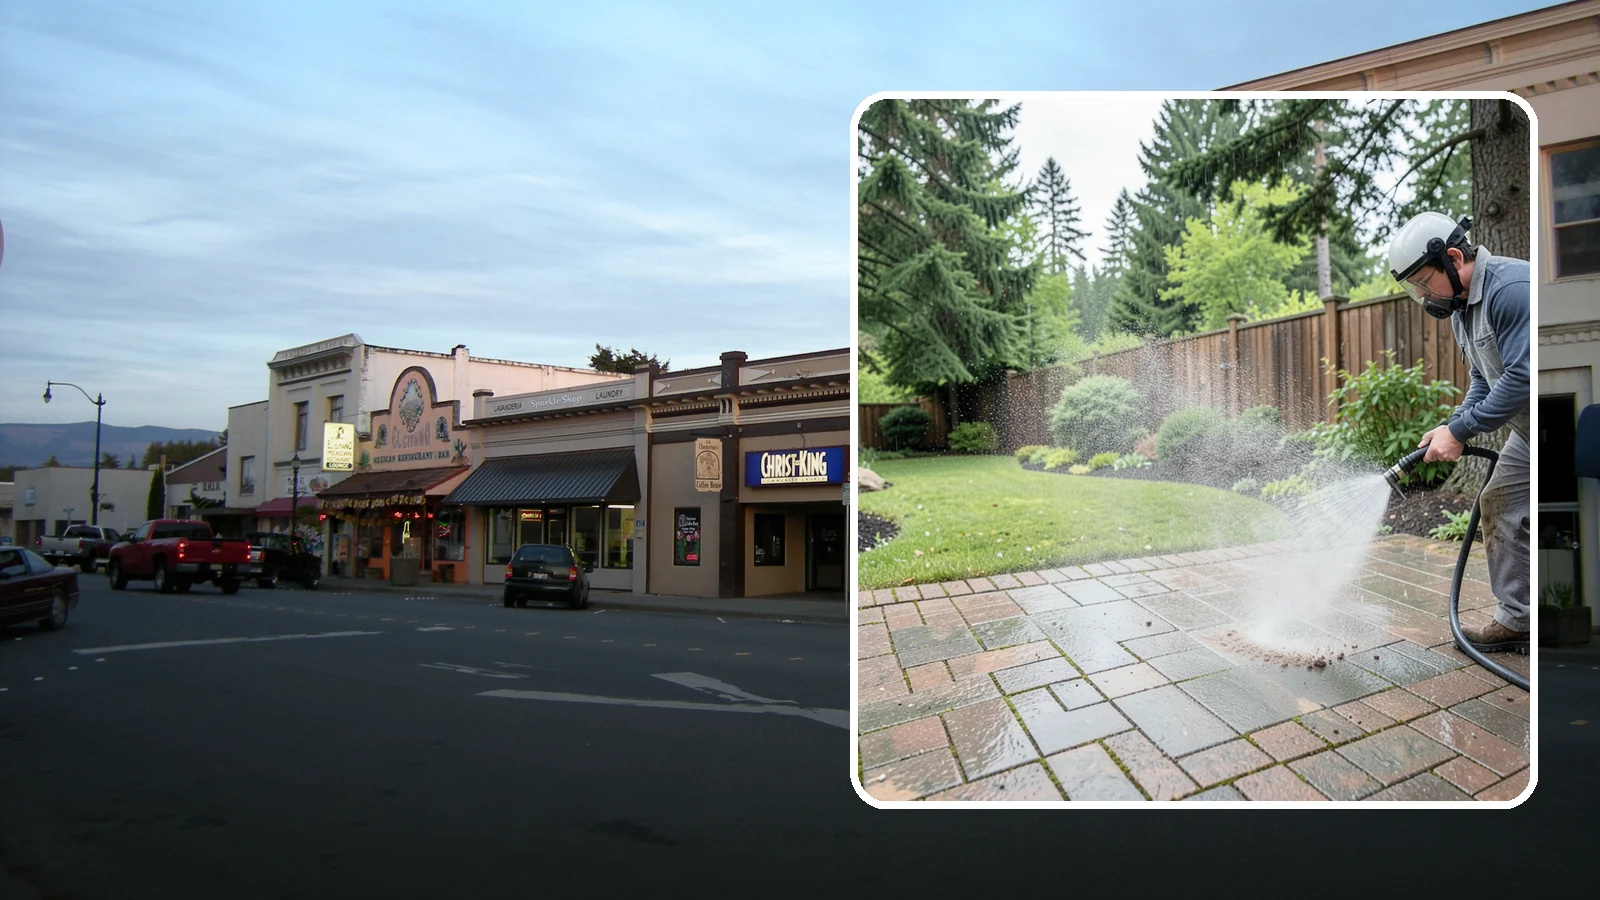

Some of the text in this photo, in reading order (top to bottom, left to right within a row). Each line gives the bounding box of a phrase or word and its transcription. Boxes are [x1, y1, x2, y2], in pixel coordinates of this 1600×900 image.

[562, 394, 582, 406] Shop
[595, 389, 624, 400] LAUNDRY
[493, 402, 523, 413] LAVANDERIA
[373, 455, 396, 464] MEXICAN
[397, 451, 434, 462] RESTAURANT
[437, 450, 450, 459] BAR
[760, 450, 827, 478] CHRIST KING
[696, 480, 722, 489] Coffee House
